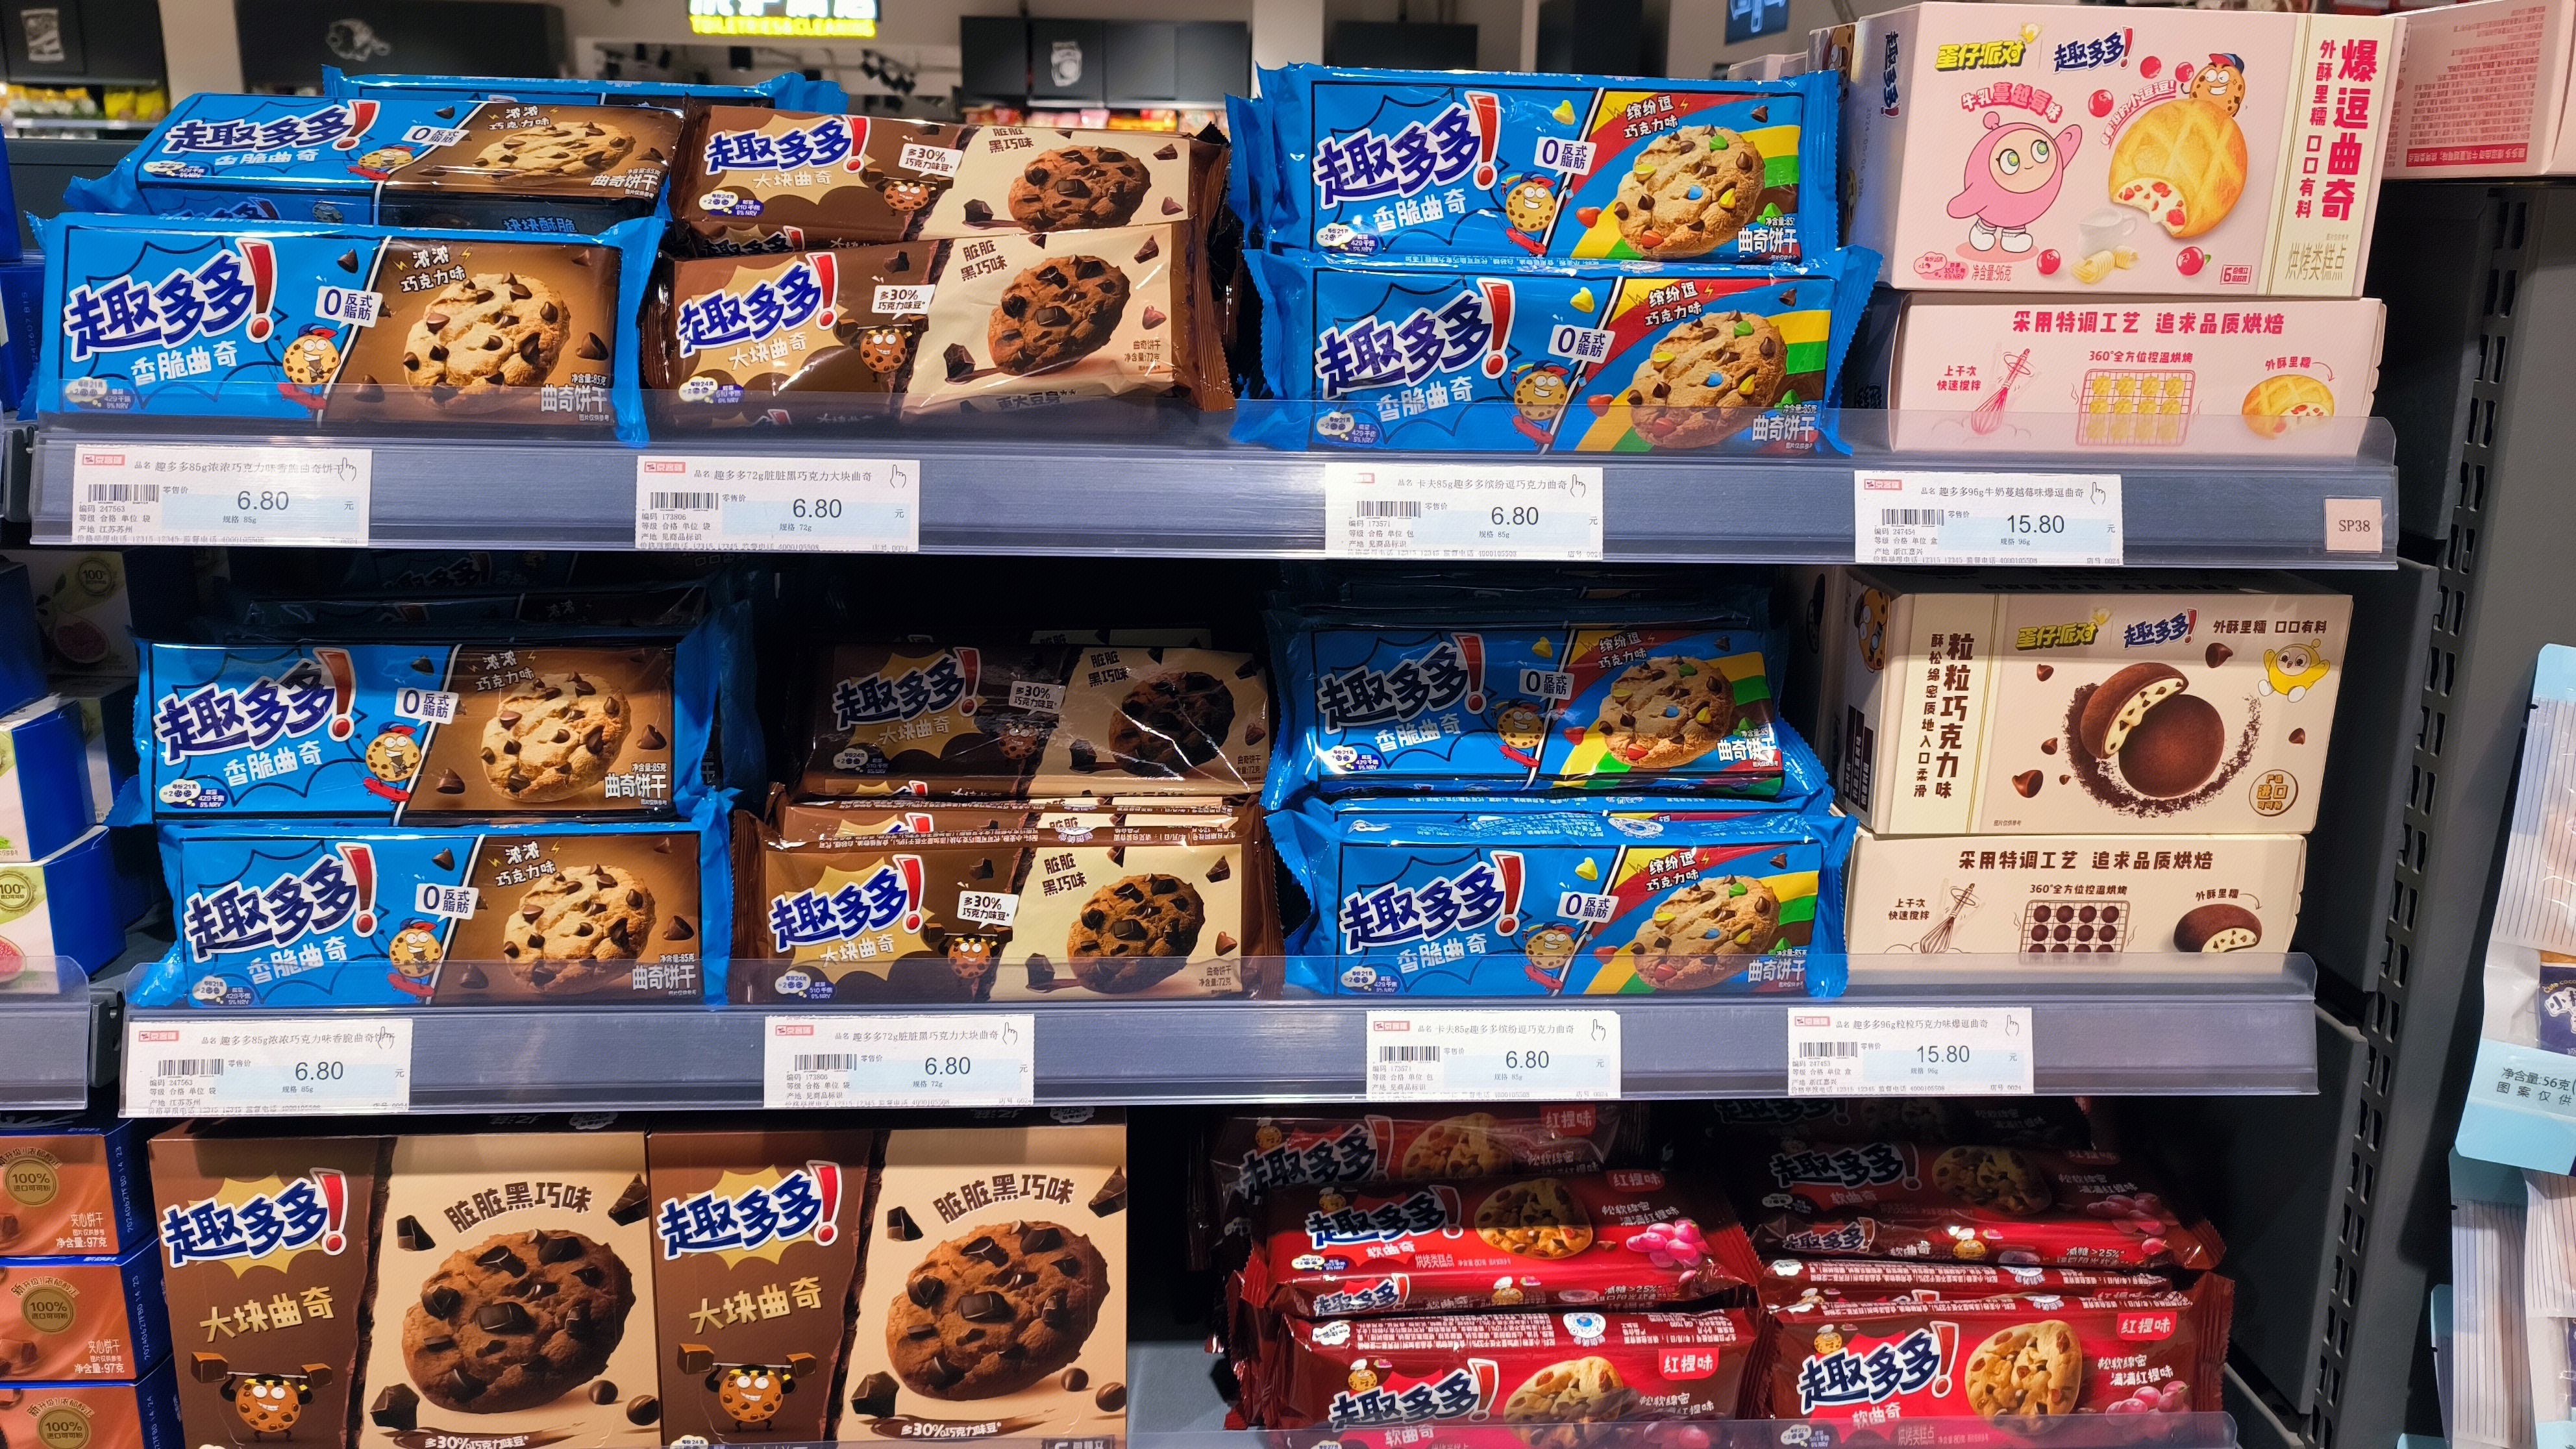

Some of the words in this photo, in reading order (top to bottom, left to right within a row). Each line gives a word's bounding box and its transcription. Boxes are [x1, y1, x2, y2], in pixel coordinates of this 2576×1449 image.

[1936, 40, 2025, 70] 蛋仔派对
[2053, 27, 2133, 73] 趣多多!
[2309, 40, 2336, 127] 外酥里糯
[1626, 95, 1674, 121] 缤纷逗
[1961, 82, 2062, 122] 牛乳蔓越莓味
[164, 101, 380, 153] 趣多多!
[488, 118, 551, 130] 巧克力味
[1624, 115, 1679, 139] 巧克力味
[2322, 38, 2378, 221] 爆逗曲奇
[705, 115, 870, 175] 趣多多!
[988, 136, 1034, 153] 黑巧味
[1313, 91, 1501, 209] 趣多多!
[591, 174, 658, 190] 曲奇饼干
[752, 170, 832, 190] 大块曲奇
[2296, 134, 2322, 218] 口口有料
[1372, 188, 1467, 232] 香脆曲奇
[962, 240, 997, 262] 脏脏
[1738, 228, 1798, 253] 曲奇饼干
[412, 245, 451, 269] 浓浓
[960, 254, 1008, 281] 黑巧味
[401, 265, 467, 293] 巧克力味
[64, 238, 277, 361] 趣多多!
[677, 252, 839, 358] 趣多多!
[1648, 281, 1698, 308] 缤纷逗
[1645, 301, 1703, 327] 巧克力味
[2012, 310, 2141, 334] 采用特调工艺
[2155, 312, 2285, 335] 追求品质烘焙
[728, 332, 807, 371] 大块曲奇
[1315, 277, 1515, 400] 趣多多!
[130, 340, 238, 386] 香脆曲奇
[1937, 378, 1982, 392] 快速搅拌
[541, 385, 609, 414] 曲奇饼干
[1376, 376, 1473, 423] 香脆曲奇
[1752, 415, 1816, 442] 曲奇饼干
[713, 470, 872, 482] 趣多多72g脏脏黑巧克力大块曲奇
[100, 504, 126, 513] 247563
[237, 491, 290, 511] 6.80
[793, 499, 842, 518] 6.80
[895, 508, 904, 519] 元
[1491, 507, 1539, 526] 6.80
[1589, 516, 1598, 526] 元
[2007, 515, 2065, 534] 15.80
[2107, 524, 2116, 534] 元
[2338, 519, 2371, 534] SP38
[2016, 621, 2099, 651] 蛋仔派对
[2122, 608, 2199, 650] 趣多多!
[2212, 620, 2267, 635] 外酥里糯
[2275, 620, 2327, 634] 口口有料
[1600, 632, 1642, 654] 缤纷逗
[482, 650, 517, 670] 浓浓
[1598, 648, 1648, 670] 巧克力味
[476, 668, 535, 692] 巧克力味
[832, 647, 981, 731] 趣多多!
[1317, 632, 1486, 735] 趣多多!
[155, 647, 356, 765] 趣多多!
[1935, 632, 1975, 799] 粒粒巧克力味
[879, 715, 950, 746] 大块曲奇
[1375, 713, 1462, 753] 香脆曲奇
[223, 740, 322, 787] 香脆曲奇
[604, 772, 667, 799] 曲奇饼干
[495, 860, 557, 887] 巧克力味
[1043, 852, 1077, 874] 脏脏
[1649, 852, 1696, 875] 缤纷逗
[1959, 850, 2078, 870] 采用特调工艺
[2092, 850, 2214, 871] 追求品质烘焙
[1042, 872, 1087, 897] 黑巧味
[1646, 871, 1700, 893] 巧克力味
[184, 842, 377, 964] 趣多多!
[769, 854, 924, 952] 趣多多!
[1339, 850, 1525, 954] 趣多多!
[247, 935, 348, 985] 香脆曲奇
[819, 934, 895, 969] 大块曲奇
[1396, 933, 1487, 974] 香脆曲奇
[632, 964, 696, 991] 曲奇饼干
[1748, 959, 1806, 983] 曲奇饼干
[924, 1057, 971, 1076] 6.80
[1505, 1050, 1550, 1069] 6.80
[1916, 1045, 1970, 1063] 15.80
[295, 1061, 344, 1082] 6.80
[395, 1069, 404, 1078] 元
[12, 1173, 51, 1185] 100%
[1768, 1141, 1922, 1191] 趣多多!
[444, 1182, 594, 1235] 脏脏黑巧味
[658, 1160, 841, 1261] 趣多多!
[933, 1173, 1076, 1226] 脏脏黑巧味
[161, 1168, 349, 1269] 趣多多!
[1306, 1185, 1465, 1250] 趣多多!
[56, 1237, 108, 1249] 净含量:97克
[1366, 1241, 1416, 1259] 软曲奇
[29, 1301, 68, 1312] 100%
[200, 1286, 334, 1343] 大块曲奇
[689, 1276, 823, 1335] 大块曲奇
[2121, 1316, 2172, 1335] 红提味
[74, 1363, 125, 1374] 净含量:97克
[1663, 1354, 1718, 1374] 红提味
[1797, 1320, 1960, 1415] 趣多多!
[2098, 1355, 2147, 1370] 松软绵密
[1328, 1357, 1500, 1433] 趣多多!
[1852, 1402, 1901, 1426] 软曲奇
[1384, 1424, 1435, 1447] 软曲奇
